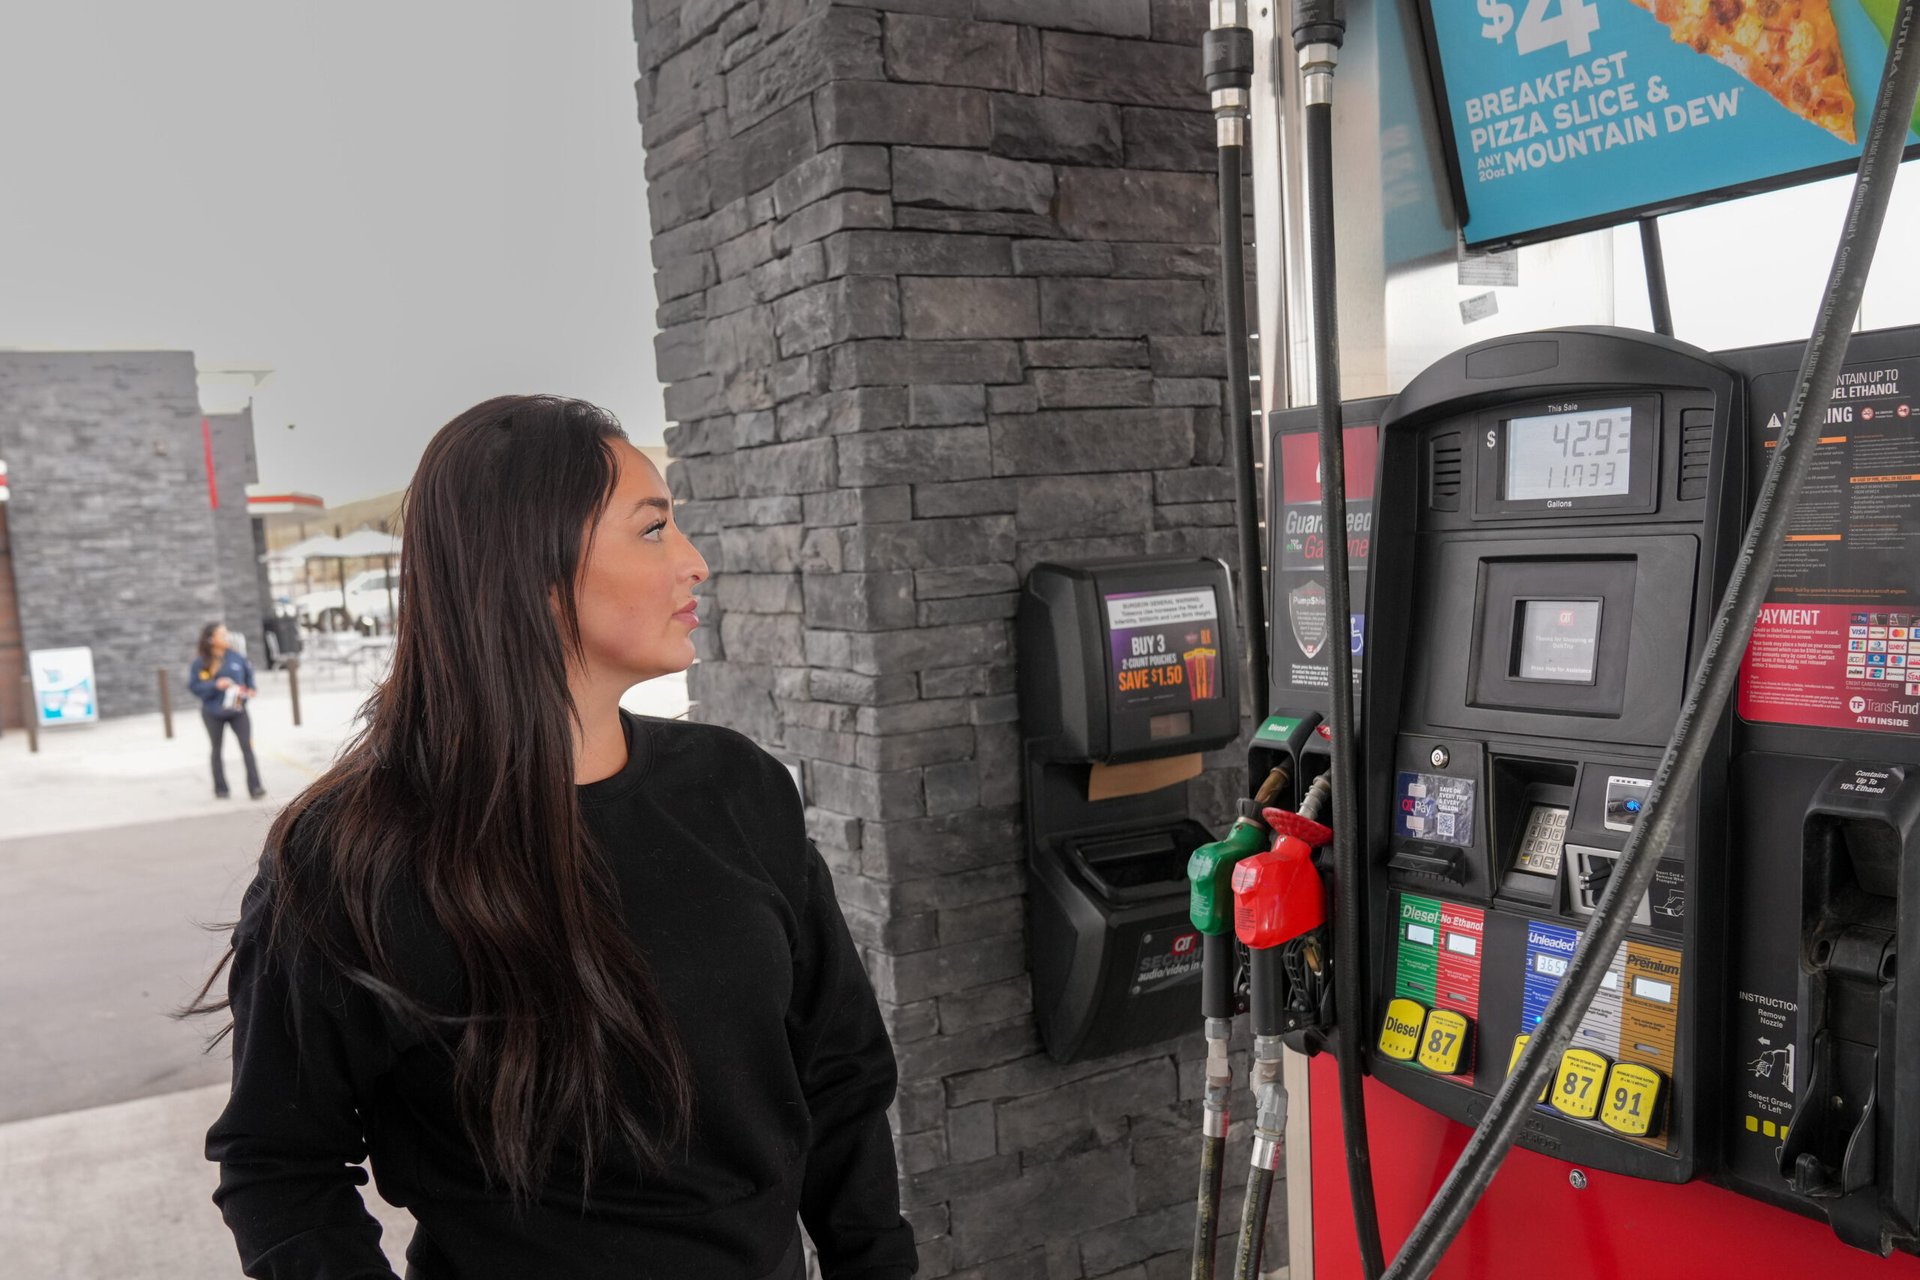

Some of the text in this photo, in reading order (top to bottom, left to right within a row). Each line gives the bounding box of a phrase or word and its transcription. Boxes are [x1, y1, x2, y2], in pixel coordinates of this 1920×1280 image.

[1477, 0, 1600, 58] $4
[1889, 5, 1913, 79] FUTURA
[1465, 52, 1624, 124] BREAKFAST
[1470, 75, 1669, 153] PIZZA SLICE &
[1504, 87, 1740, 175] MOUNTAIN DEW
[1477, 153, 1502, 170] ANY
[1478, 168, 1506, 182] 20oz
[1836, 369, 1899, 386] NTAIN UP TO
[1849, 383, 1899, 398] ETHANOL
[1563, 403, 1578, 411] Sale
[1779, 382, 1813, 454] FUTURA
[1486, 430, 1496, 448] $
[1548, 462, 1616, 488] 11.733
[1547, 500, 1572, 508] Gallons
[1285, 511, 1372, 534] Guareed
[1304, 535, 1370, 559] Gaine
[1131, 633, 1166, 656] BUY 3
[1122, 653, 1177, 670] 2-COUNT POUCHES
[1118, 664, 1182, 692] SAVE $1.50
[1867, 698, 1919, 715] TransFund
[1856, 716, 1909, 727] ATM INSIDE
[1855, 770, 1889, 779] Contains
[1855, 785, 1885, 793] Ethanol
[1414, 800, 1431, 816] Pay
[1402, 904, 1439, 924] Diesel
[1440, 914, 1483, 931] No Ethanol
[1528, 932, 1575, 952] Unleaded
[1140, 946, 1203, 971] SECURI
[1627, 953, 1680, 976] Premium
[1137, 960, 1199, 982] audio/video in
[1758, 1008, 1786, 1021] Remove
[1760, 1017, 1783, 1029] Nozzle
[1385, 1016, 1420, 1039] Diesel
[1428, 1029, 1457, 1056] 87
[1563, 1072, 1593, 1099] 87
[1613, 1087, 1641, 1116] 91
[1747, 1090, 1792, 1110] Select Grade
[1758, 1101, 1782, 1114] To Left
